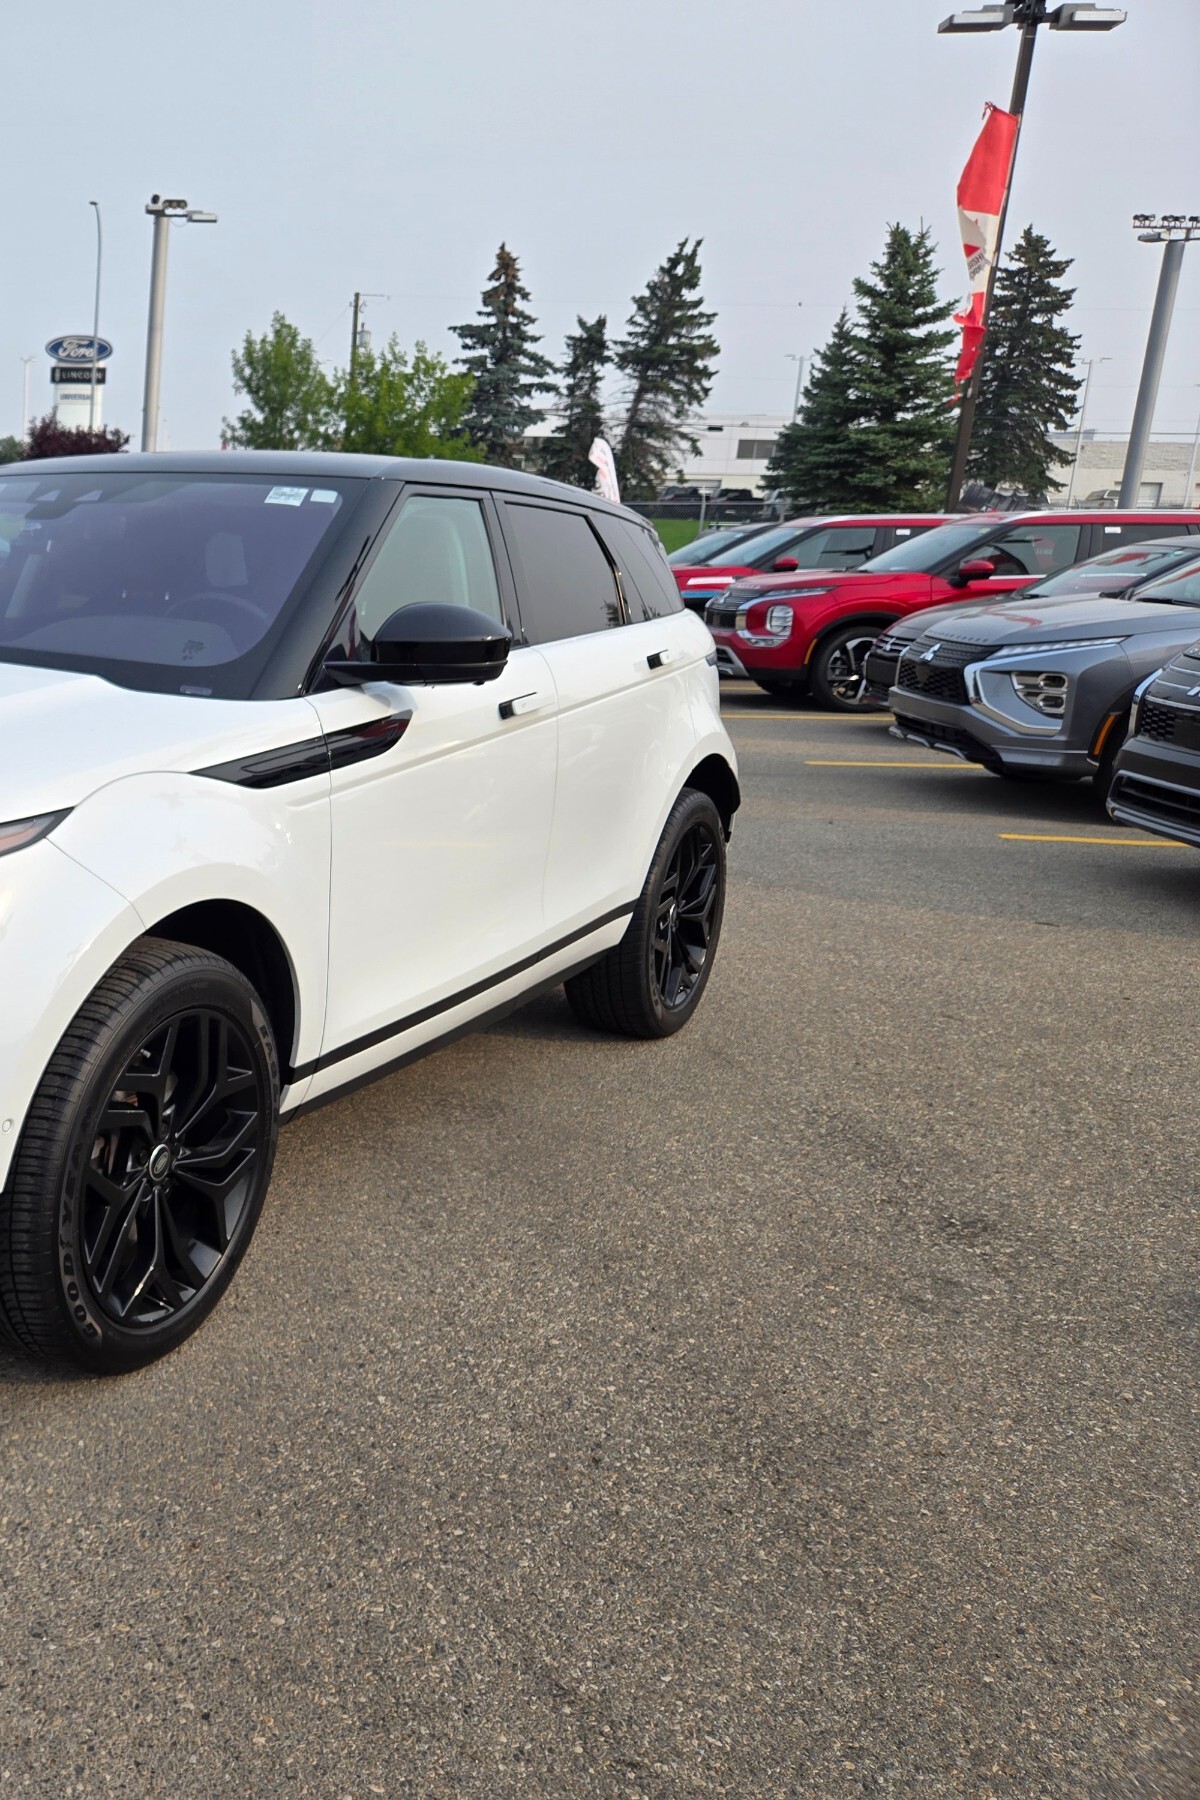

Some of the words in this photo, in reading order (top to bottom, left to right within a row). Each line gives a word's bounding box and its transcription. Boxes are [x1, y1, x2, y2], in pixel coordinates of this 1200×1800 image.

[58, 339, 99, 358] Ford
[61, 371, 104, 379] LINCON
[60, 393, 94, 401] UNIVERSA
